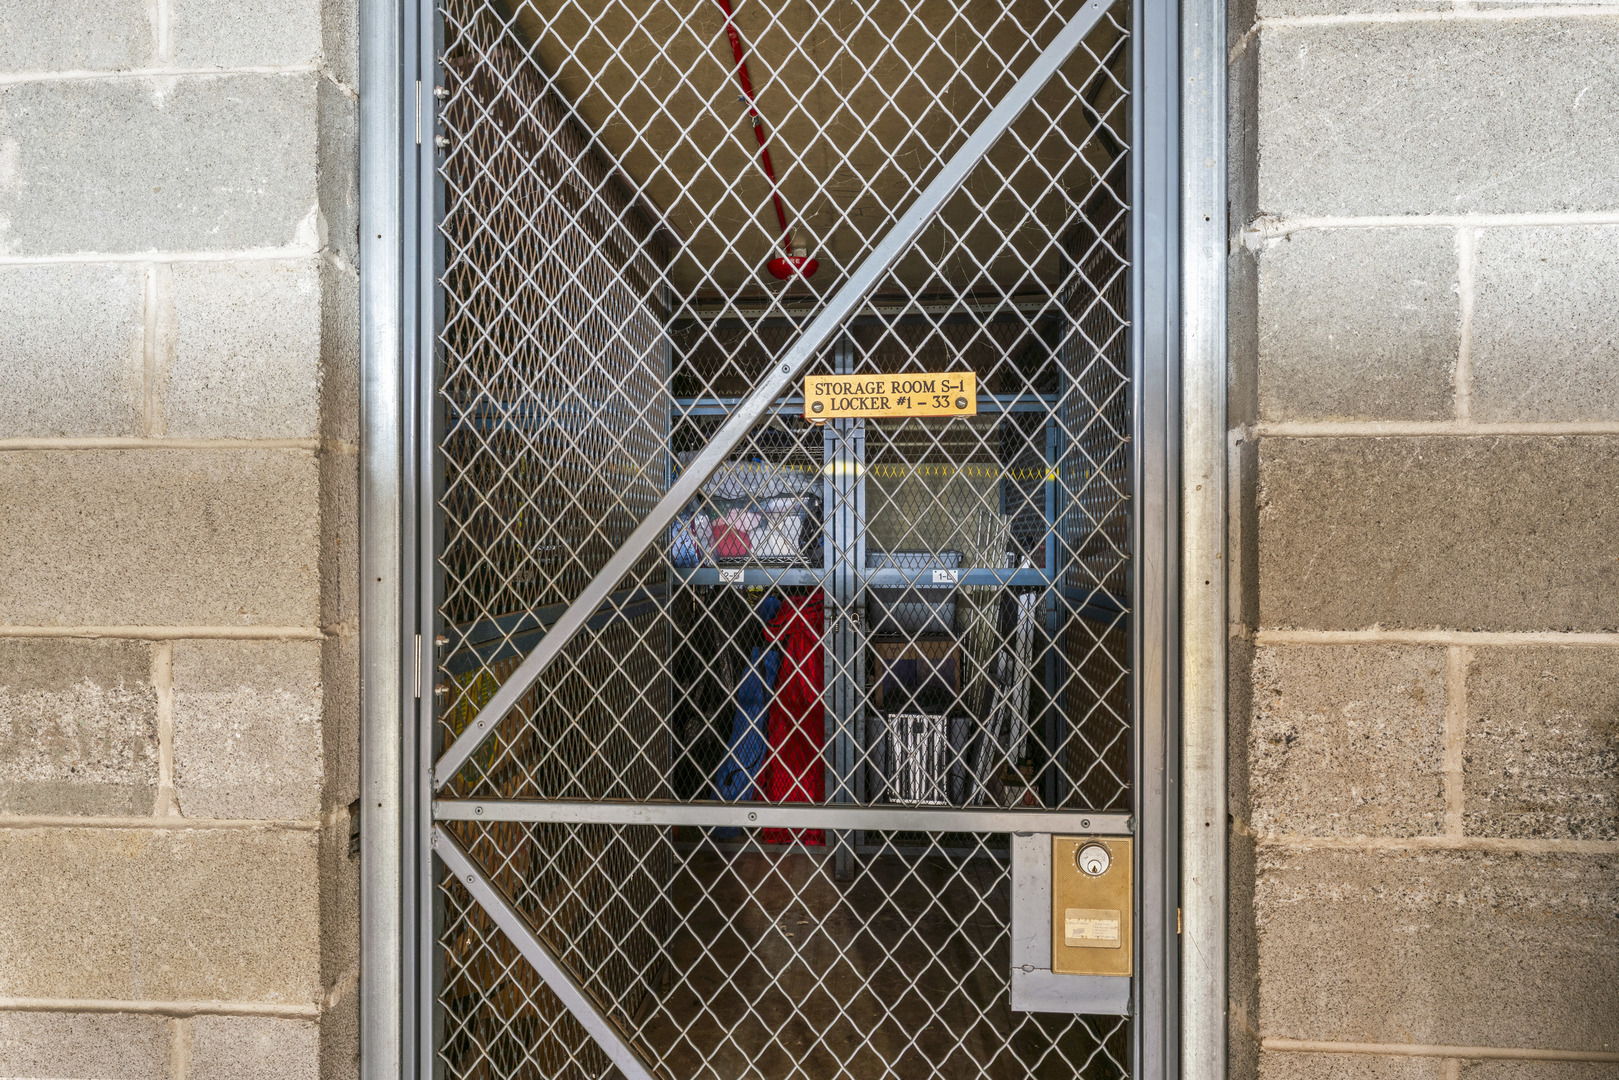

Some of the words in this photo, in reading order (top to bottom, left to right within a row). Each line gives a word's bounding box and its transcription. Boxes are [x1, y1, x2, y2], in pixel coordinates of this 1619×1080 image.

[815, 381, 885, 396] STORAGE
[891, 380, 936, 394] ROOM
[830, 396, 892, 411] LOCKER
[896, 396, 912, 409] #1
[932, 395, 950, 409] 33
